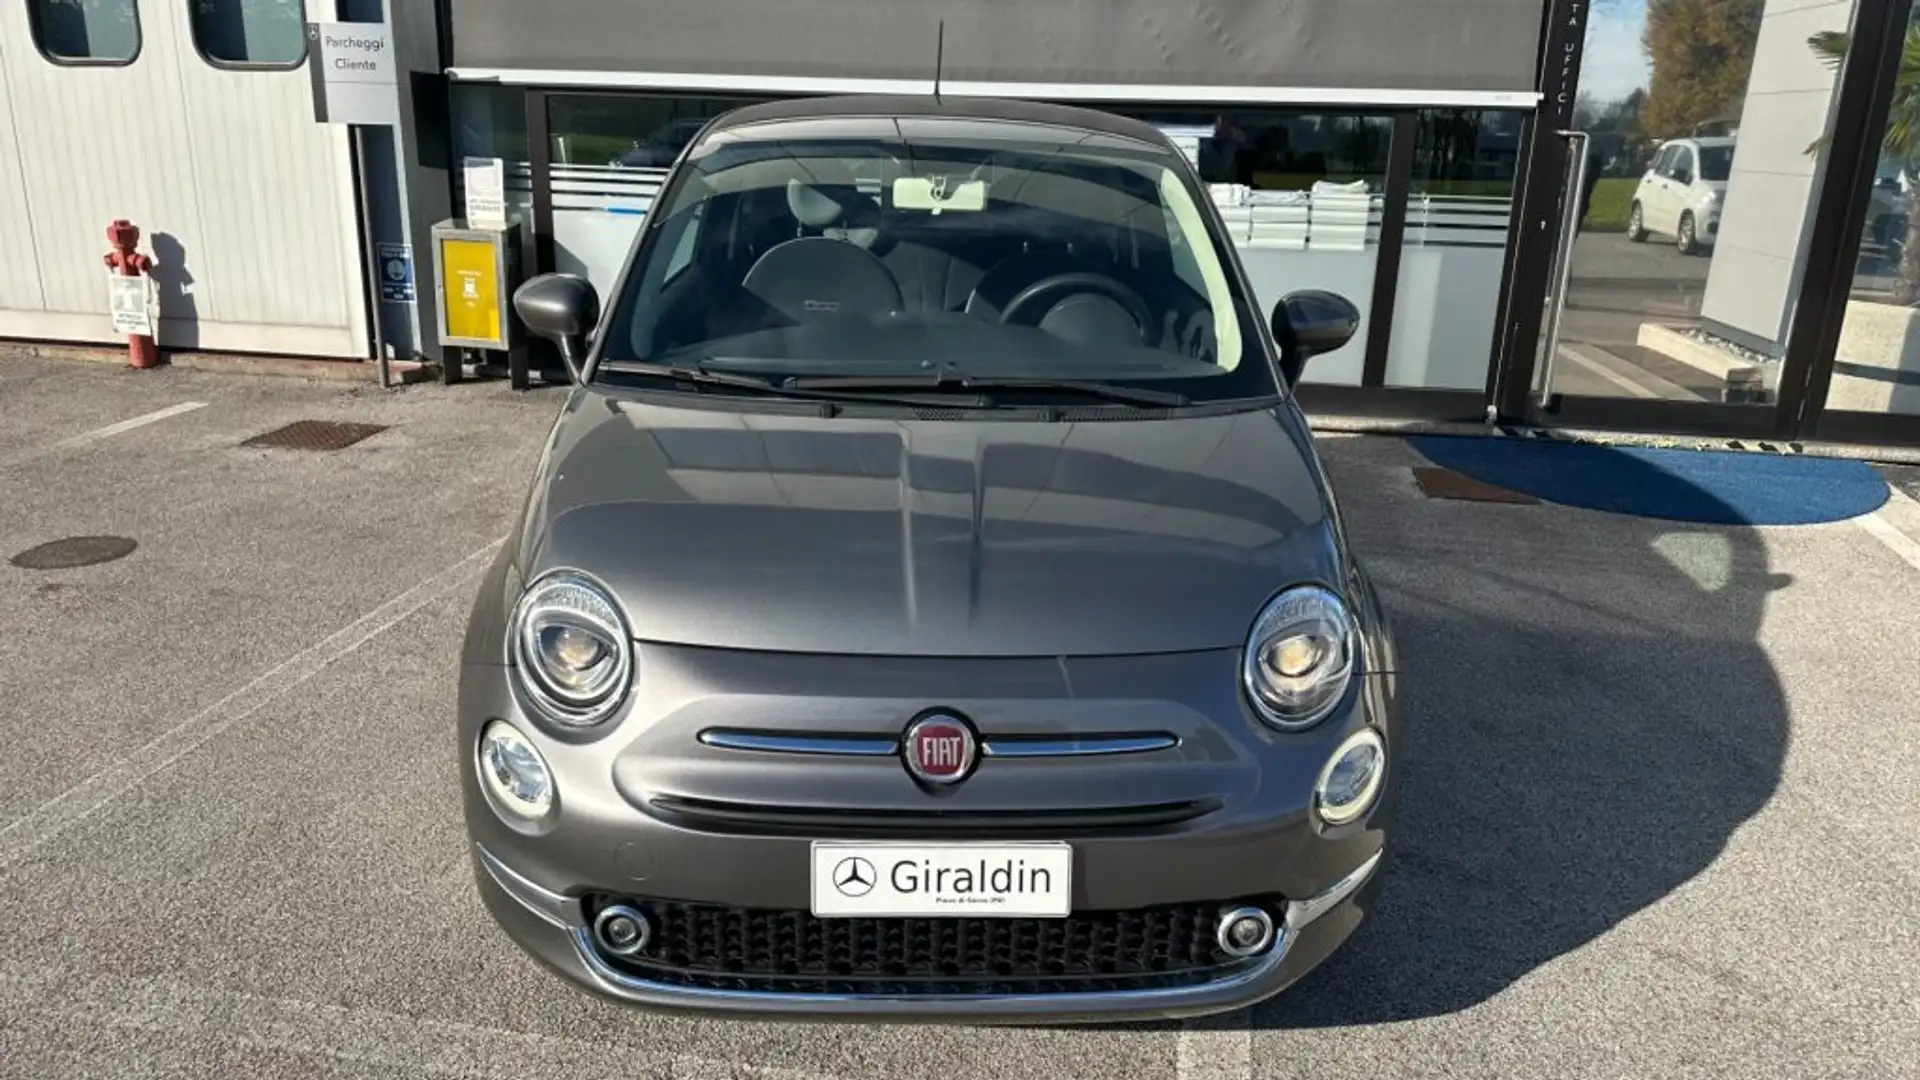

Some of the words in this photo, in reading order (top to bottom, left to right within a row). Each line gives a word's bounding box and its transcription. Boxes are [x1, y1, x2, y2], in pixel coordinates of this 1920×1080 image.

[325, 35, 385, 52] Parcheggi
[335, 58, 377, 71] Cliente
[1558, 43, 1575, 114] UFFICI
[922, 736, 961, 767] FIAT
[890, 859, 1051, 894] Giraldin
